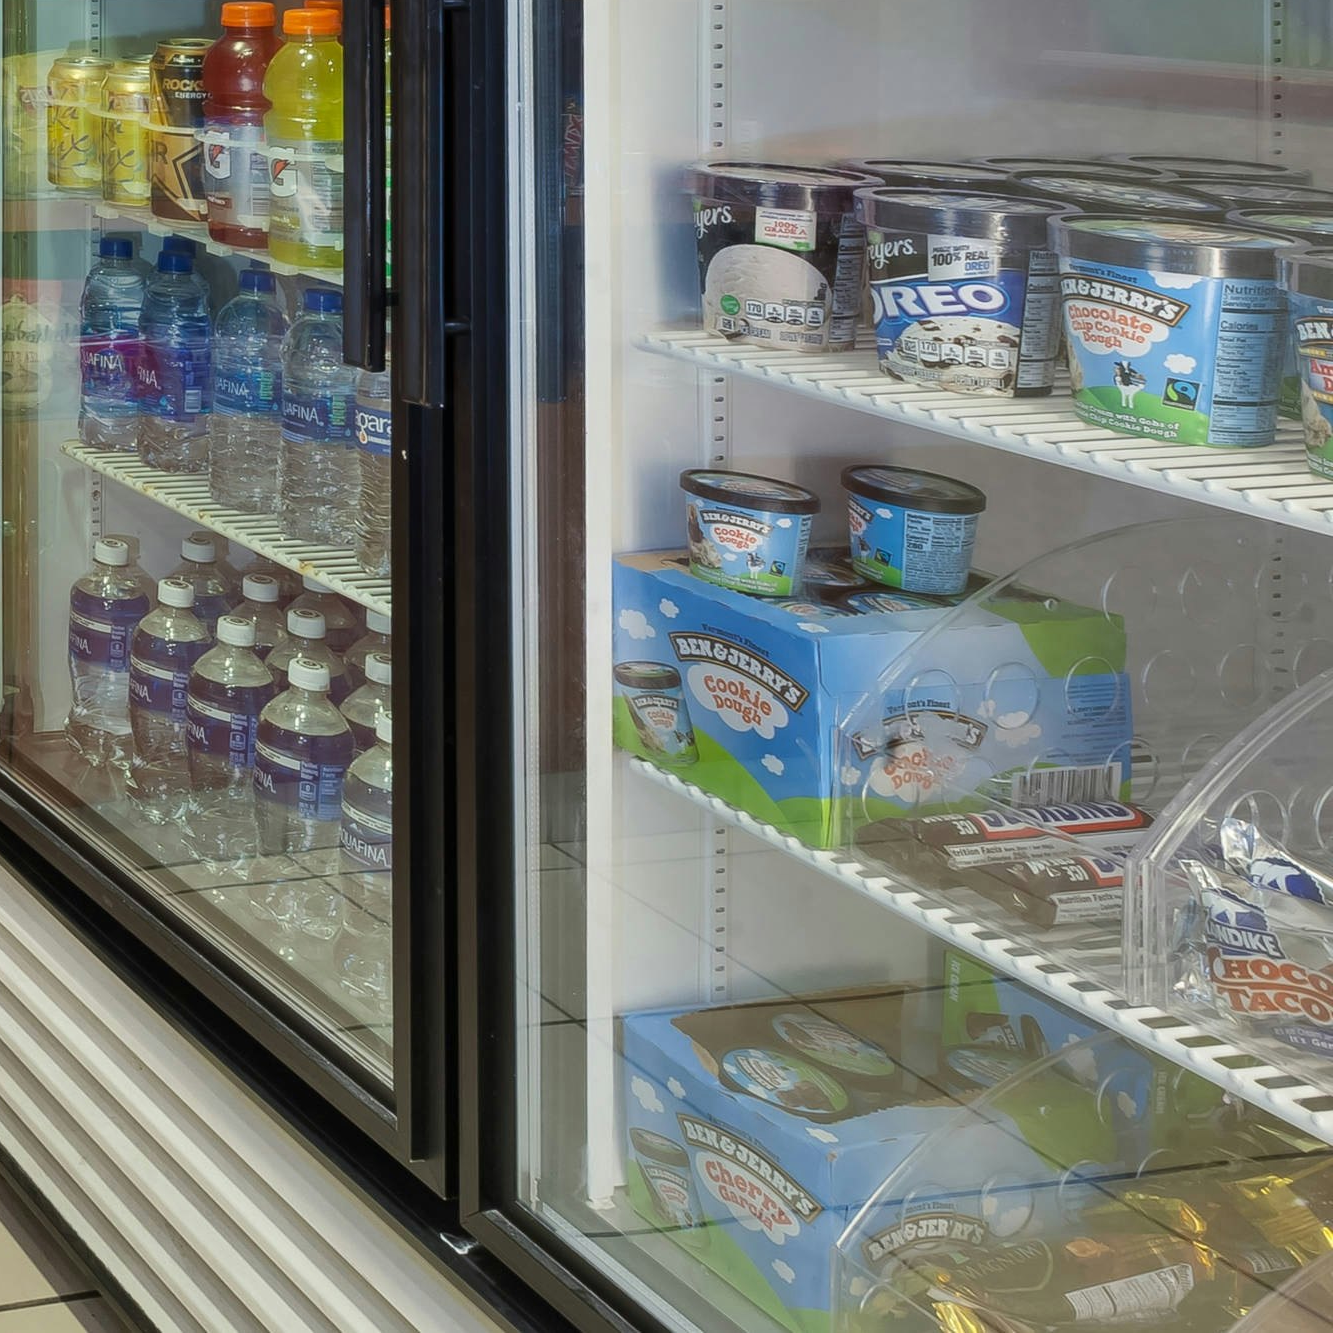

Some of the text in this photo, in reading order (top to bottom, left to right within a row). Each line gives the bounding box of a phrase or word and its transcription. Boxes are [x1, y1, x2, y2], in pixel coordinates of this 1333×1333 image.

[931, 250, 990, 267] 100% REAL
[964, 261, 990, 271] OREO
[1083, 331, 1122, 349] Dough
[1095, 322, 1146, 344] Cookie
[714, 526, 758, 544] Cookie
[704, 674, 772, 716] Cookie
[713, 694, 762, 726] Dough
[1216, 986, 1331, 1023] TACO
[705, 1160, 792, 1226] Cherry
[718, 1185, 773, 1232] Garcia
[957, 1242, 1043, 1281] MAGNUM
